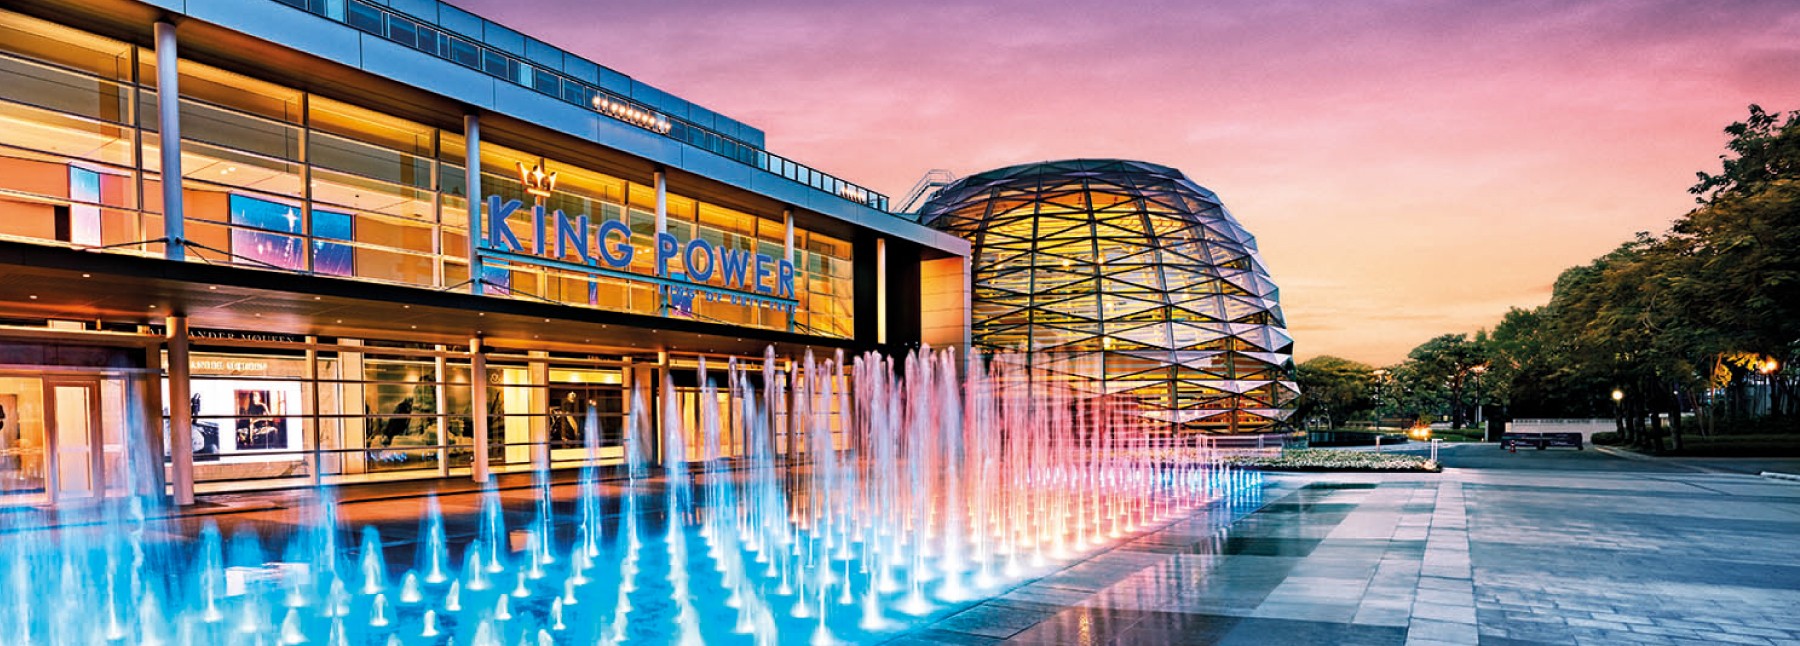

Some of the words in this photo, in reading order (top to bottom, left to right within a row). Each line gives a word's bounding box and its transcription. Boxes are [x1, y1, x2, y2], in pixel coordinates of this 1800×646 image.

[487, 194, 634, 268] KING
[655, 232, 794, 300] POWER
[149, 328, 234, 339] ALANDER
